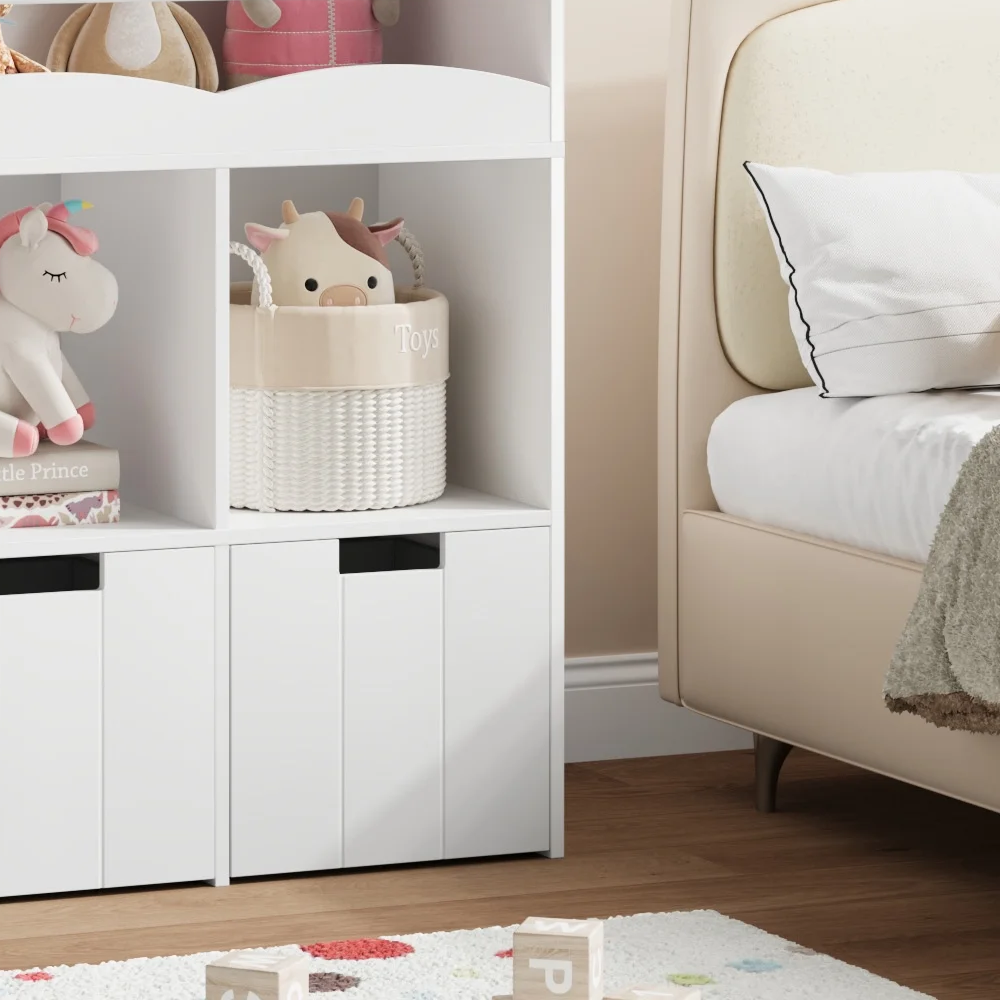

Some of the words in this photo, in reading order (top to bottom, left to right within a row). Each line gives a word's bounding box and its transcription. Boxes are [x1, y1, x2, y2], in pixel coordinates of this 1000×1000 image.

[394, 323, 440, 359] Toys
[30, 462, 89, 480] Prince
[529, 958, 573, 996] P
